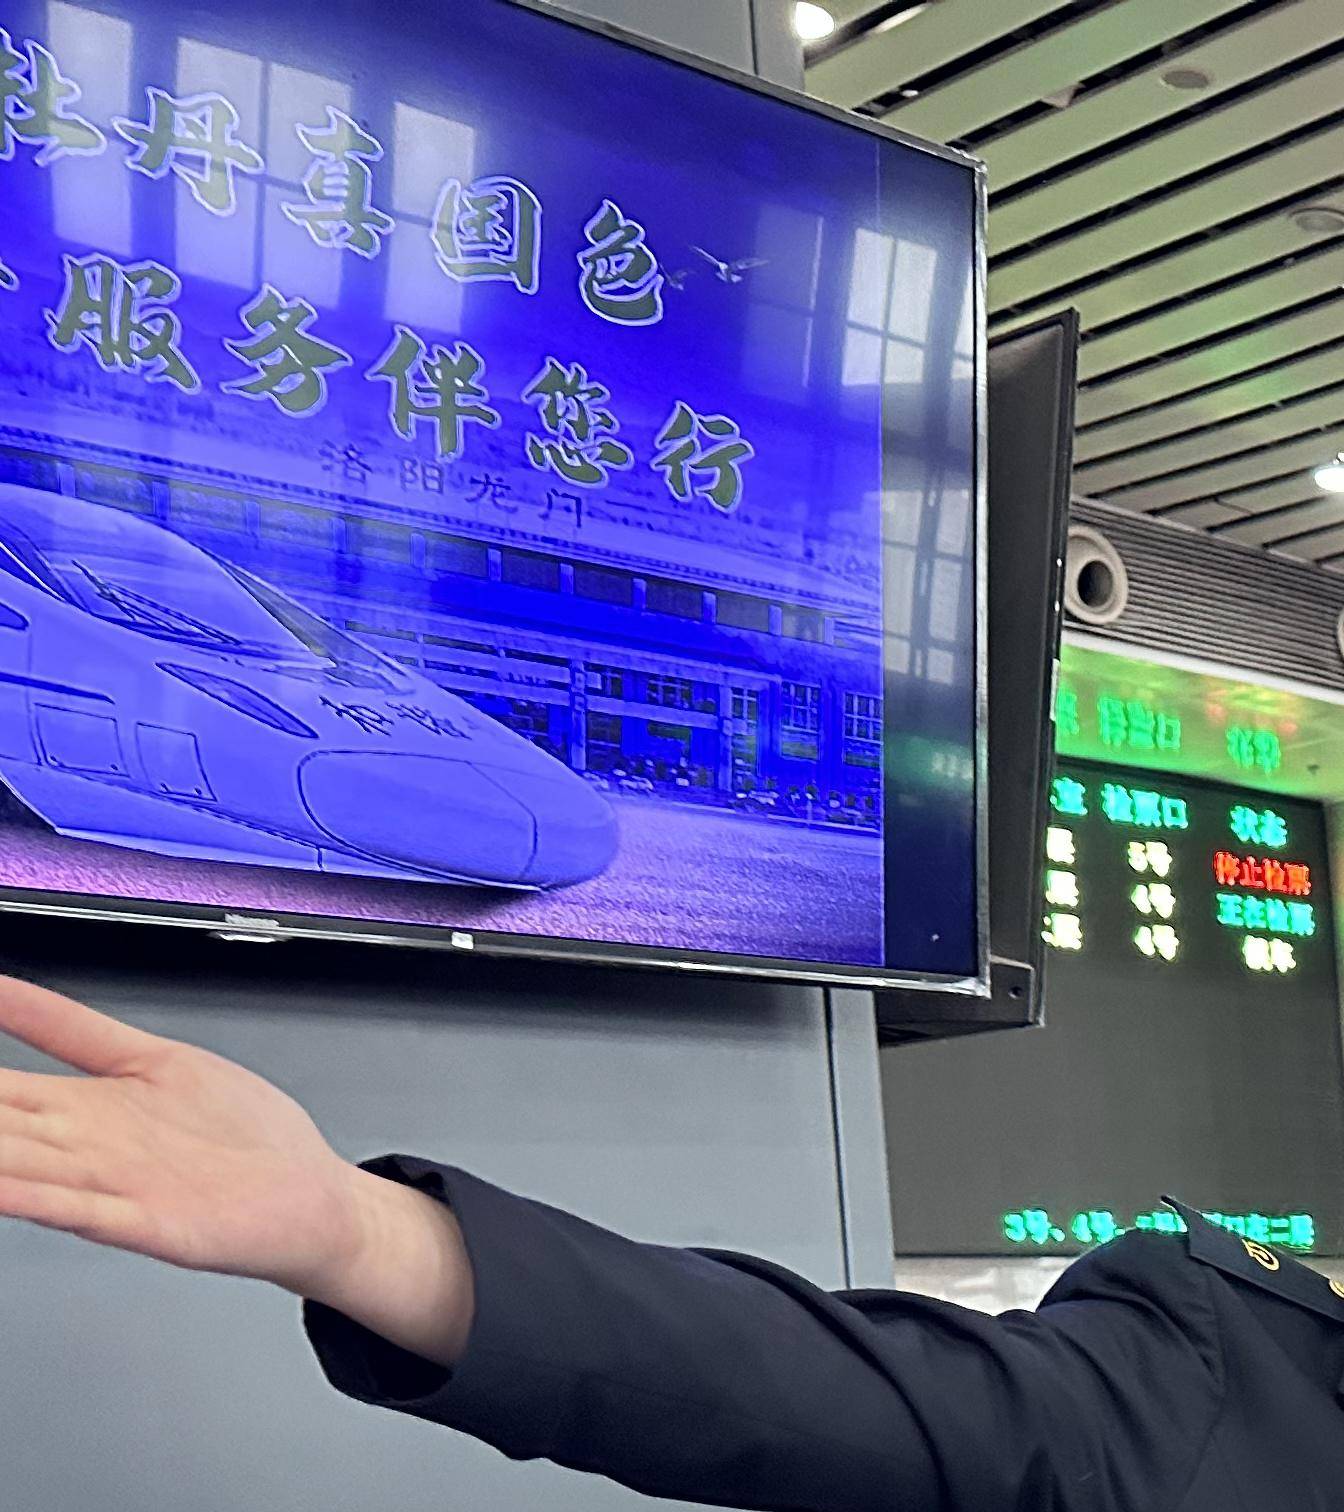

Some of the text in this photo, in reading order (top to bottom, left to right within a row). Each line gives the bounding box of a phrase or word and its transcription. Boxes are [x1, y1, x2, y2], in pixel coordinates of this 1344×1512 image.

[0, 253, 754, 512] 服务伴您行
[1214, 851, 1312, 896] 停止检票
